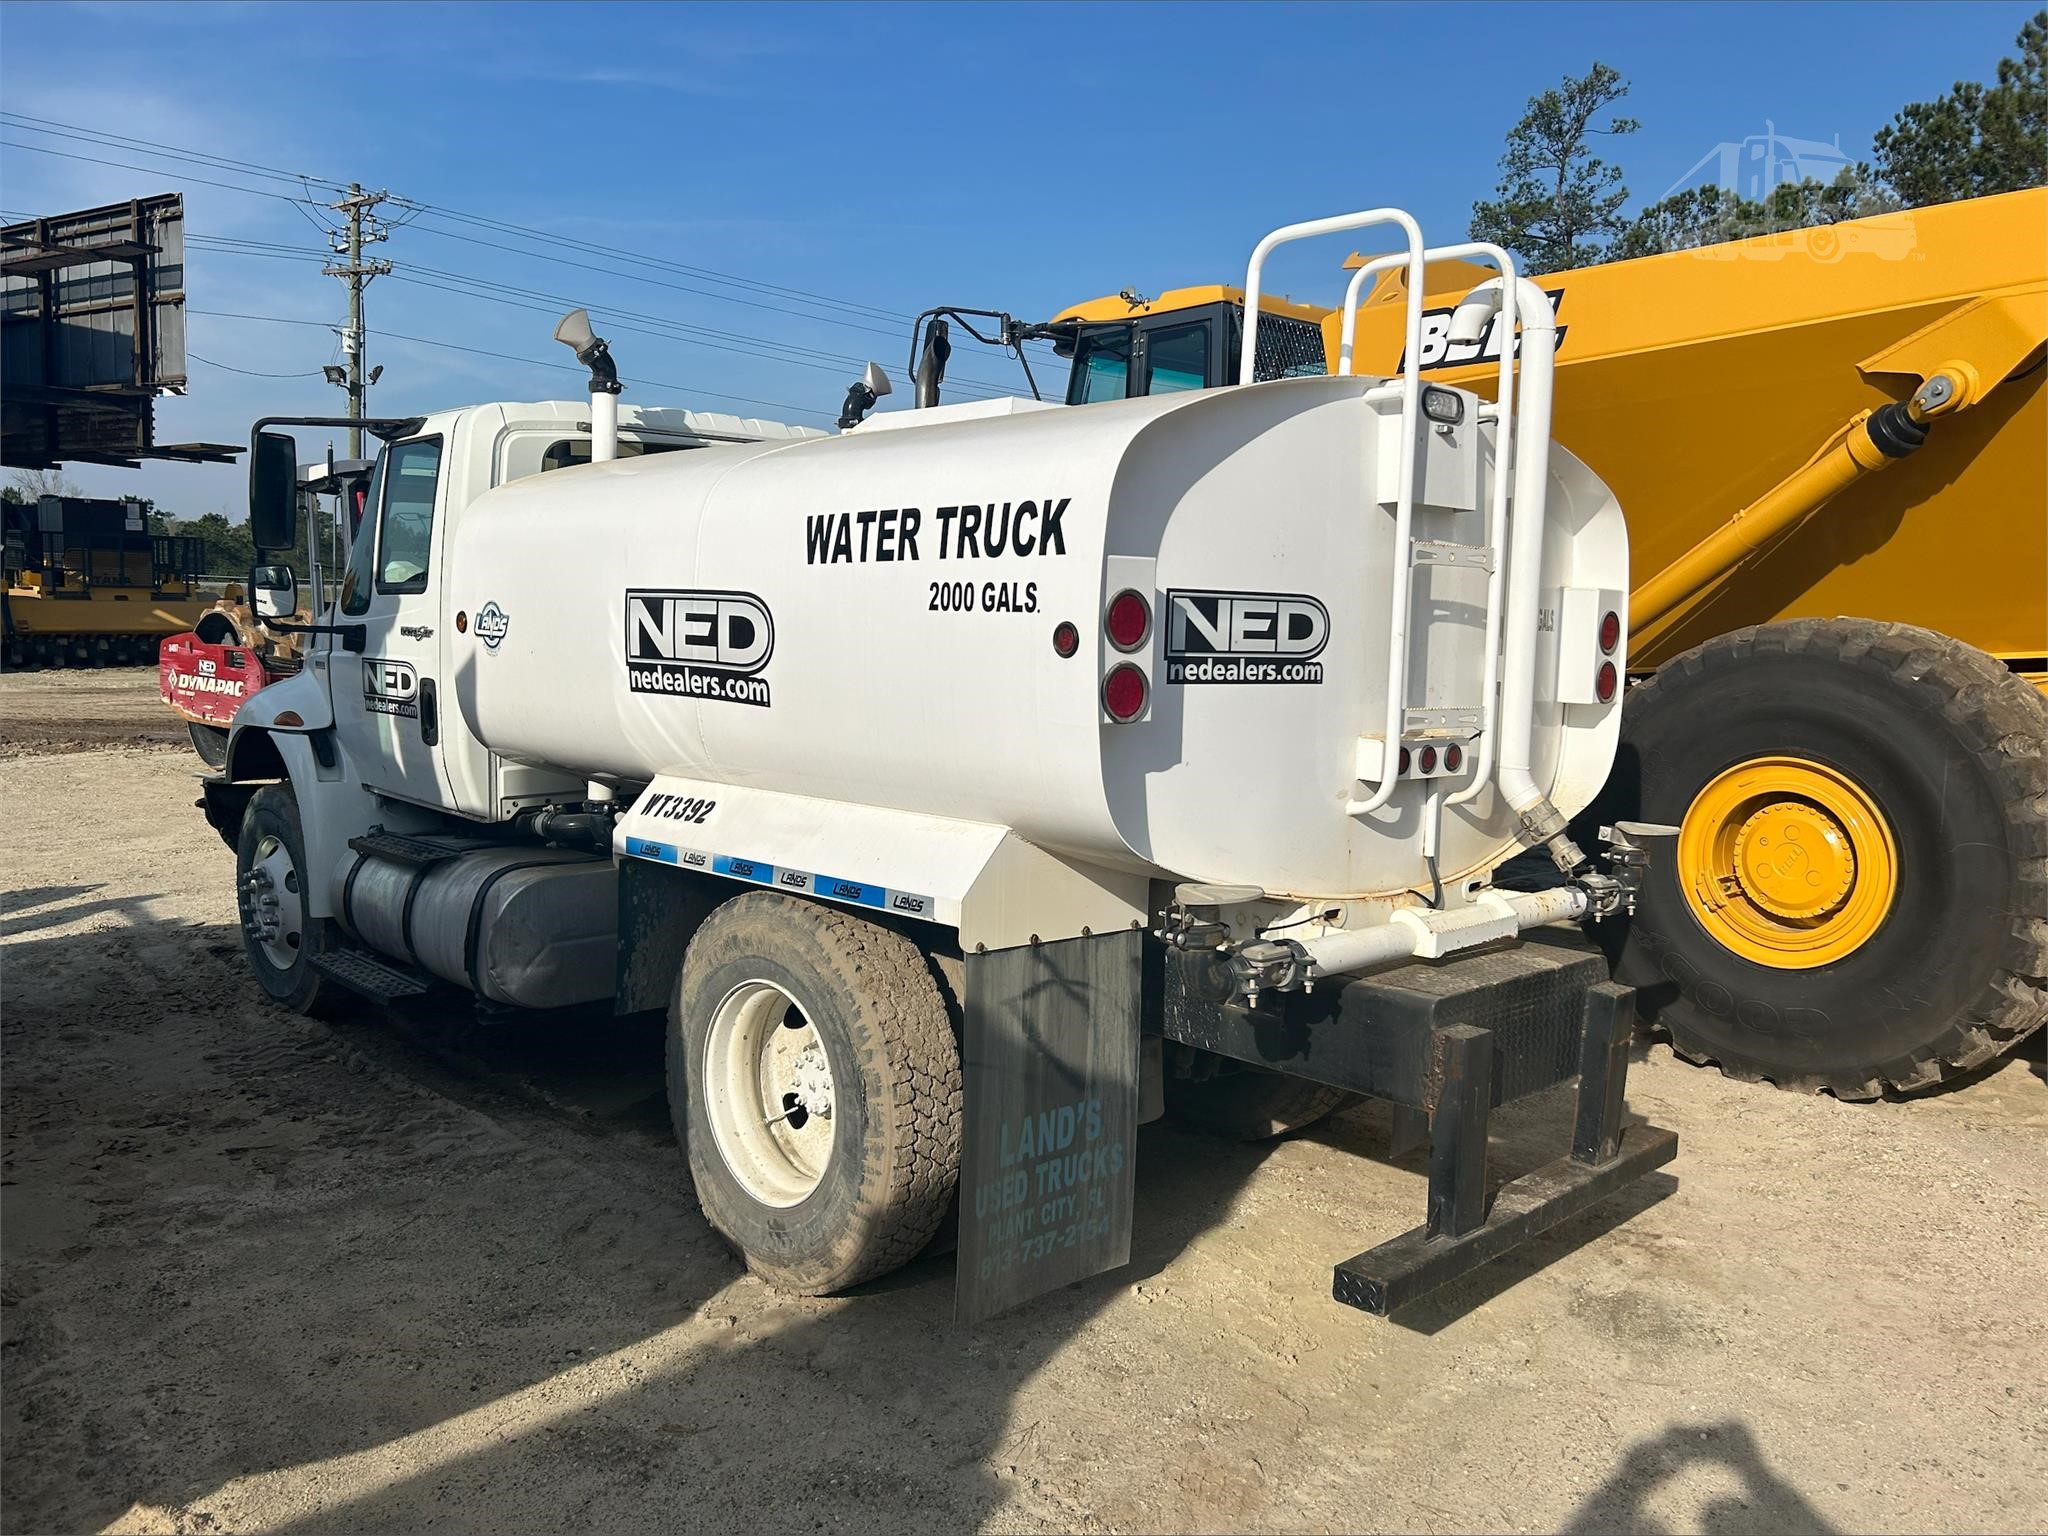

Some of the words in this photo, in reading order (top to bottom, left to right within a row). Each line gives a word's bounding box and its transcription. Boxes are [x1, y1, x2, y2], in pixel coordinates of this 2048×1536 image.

[806, 507, 922, 565] WATER
[935, 497, 1072, 560] TRUCK
[928, 581, 975, 612] 2000
[981, 581, 1041, 613] GALS.
[628, 597, 770, 665] NED
[1170, 597, 1327, 653] NED
[198, 659, 216, 673] NED
[362, 659, 418, 700] NED
[1169, 657, 1322, 682] nedealers.com
[178, 673, 244, 698] DYNAPAC
[630, 665, 769, 703] nedealers.com
[365, 698, 417, 717] nedealers.com
[640, 793, 717, 824] WT3392
[1000, 1099, 1103, 1168] LAND'S
[975, 1169, 1029, 1219] USED
[1035, 1142, 1124, 1197] TRUCKS
[1041, 1193, 1081, 1225] CITY,
